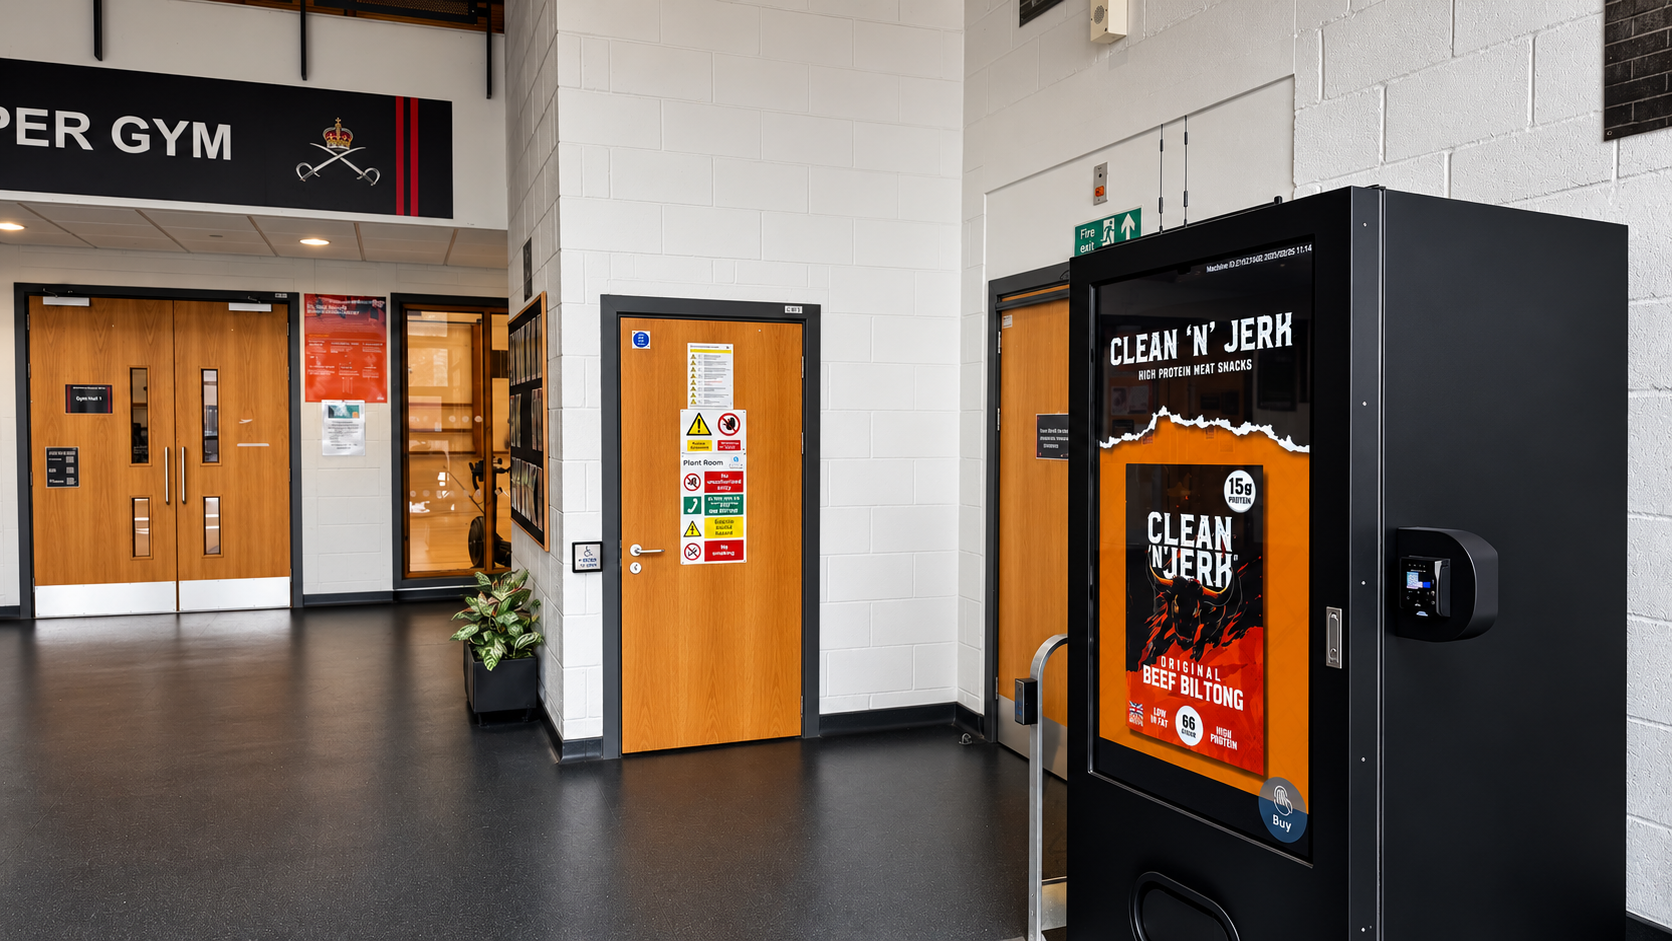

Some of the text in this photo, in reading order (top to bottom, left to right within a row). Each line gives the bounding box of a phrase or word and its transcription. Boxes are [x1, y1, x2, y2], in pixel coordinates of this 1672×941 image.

[0, 105, 231, 161] ER GYM
[1080, 228, 1095, 240] Fire
[1080, 240, 1095, 253] exit
[1110, 312, 1293, 366] CLEAN 'N' JERK
[1138, 358, 1252, 380] HIGH PROTEIN MEAT SNACKS
[683, 459, 702, 467] Plant
[703, 459, 724, 467] Room
[1228, 477, 1252, 496] 15g
[1228, 496, 1252, 505] PROTEIN
[1147, 510, 1232, 553] CLEAN
[1160, 655, 1221, 682] ORIGINAL
[1143, 664, 1244, 711] BEEF BILTONG
[1153, 706, 1167, 719] LOW
[1157, 717, 1169, 729] FAT
[1182, 714, 1196, 731] 66
[1216, 725, 1232, 739] HIGH
[1210, 733, 1238, 750] PROTEIN
[1272, 814, 1292, 833] Buy
